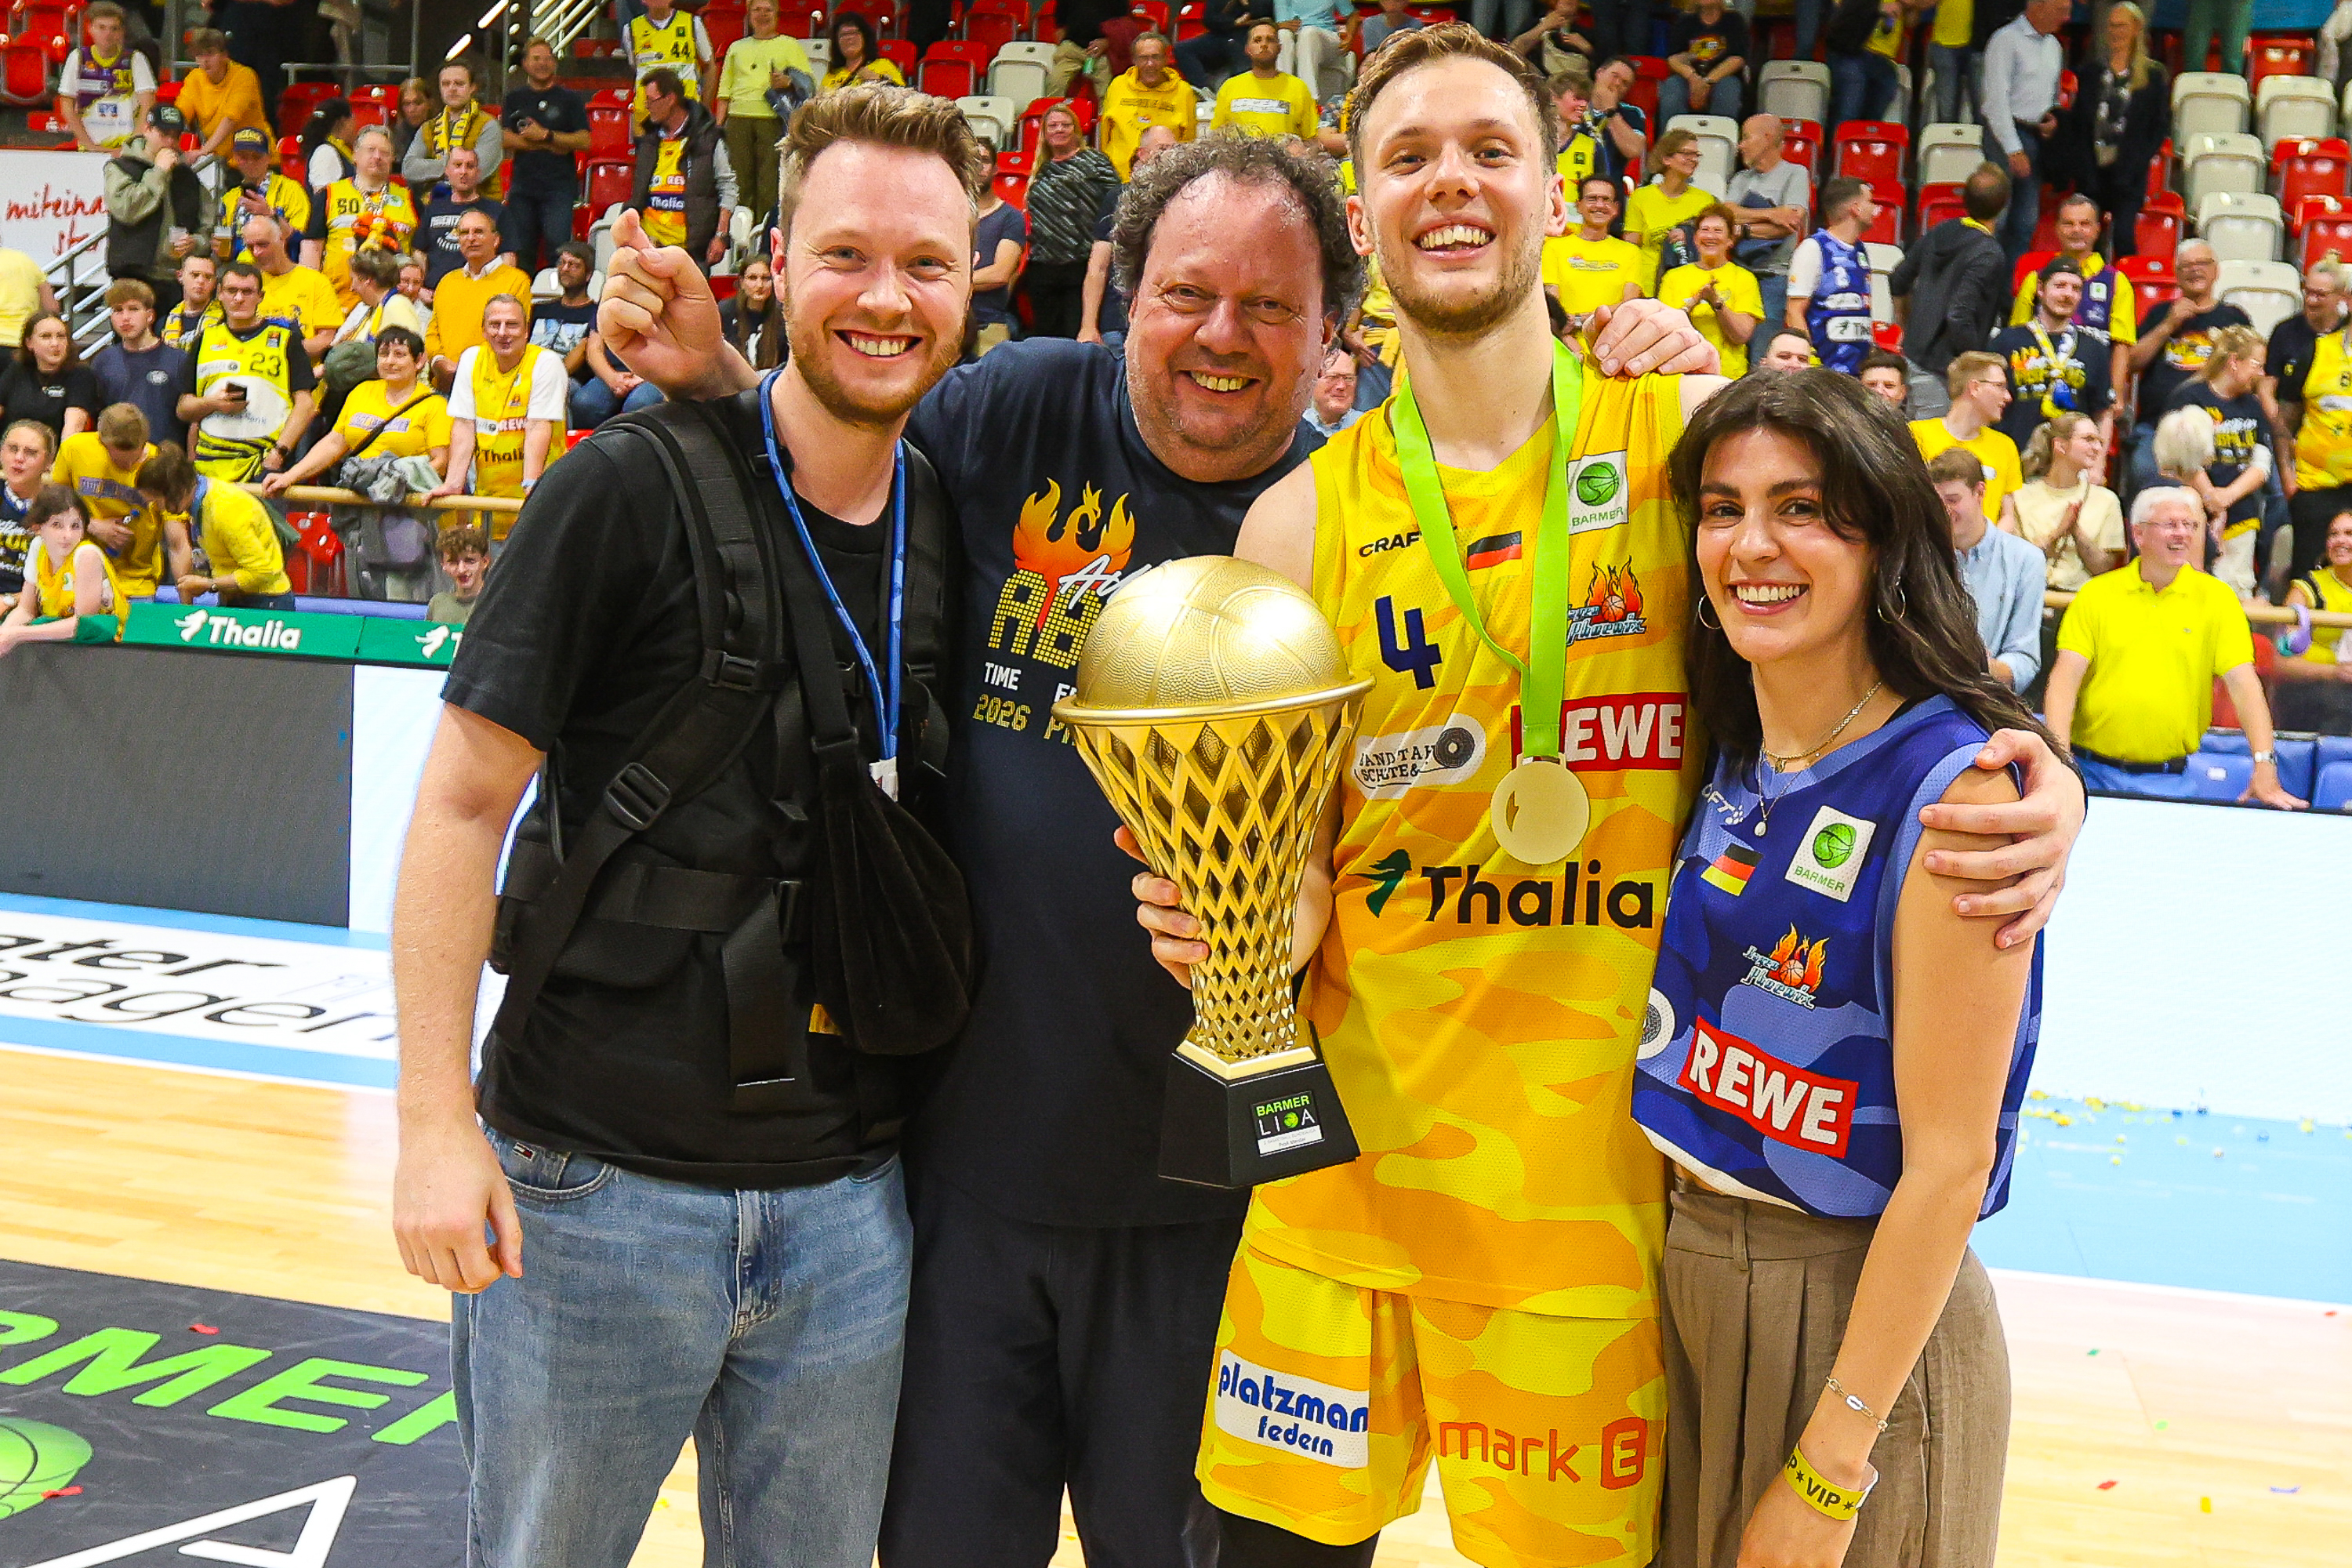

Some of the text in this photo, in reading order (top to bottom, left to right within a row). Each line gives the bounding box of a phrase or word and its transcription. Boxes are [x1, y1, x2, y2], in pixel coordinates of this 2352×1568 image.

[670, 40, 691, 59] 44
[5, 182, 109, 221] miteina
[249, 352, 281, 377] 23
[499, 417, 528, 431] REW
[484, 448, 524, 463] Thali
[1572, 506, 1624, 527] BARMER
[1359, 531, 1423, 557] CRAF
[208, 615, 302, 650] Thalia
[1374, 594, 1443, 691] 4
[1566, 612, 1646, 647] Phoenix
[985, 662, 1022, 691] TIME
[972, 693, 1032, 731] 2026
[1563, 702, 1682, 763] EWE
[1421, 859, 1653, 929] Thalia
[1794, 865, 1846, 894] BARMER
[1740, 965, 1817, 1011] Phoenix
[1689, 1028, 1847, 1146] REWE
[1256, 1095, 1310, 1117] BARMER
[1258, 1414, 1334, 1457] federn
[1439, 1421, 1581, 1483] mark
[1806, 1476, 1841, 1508] VIP
